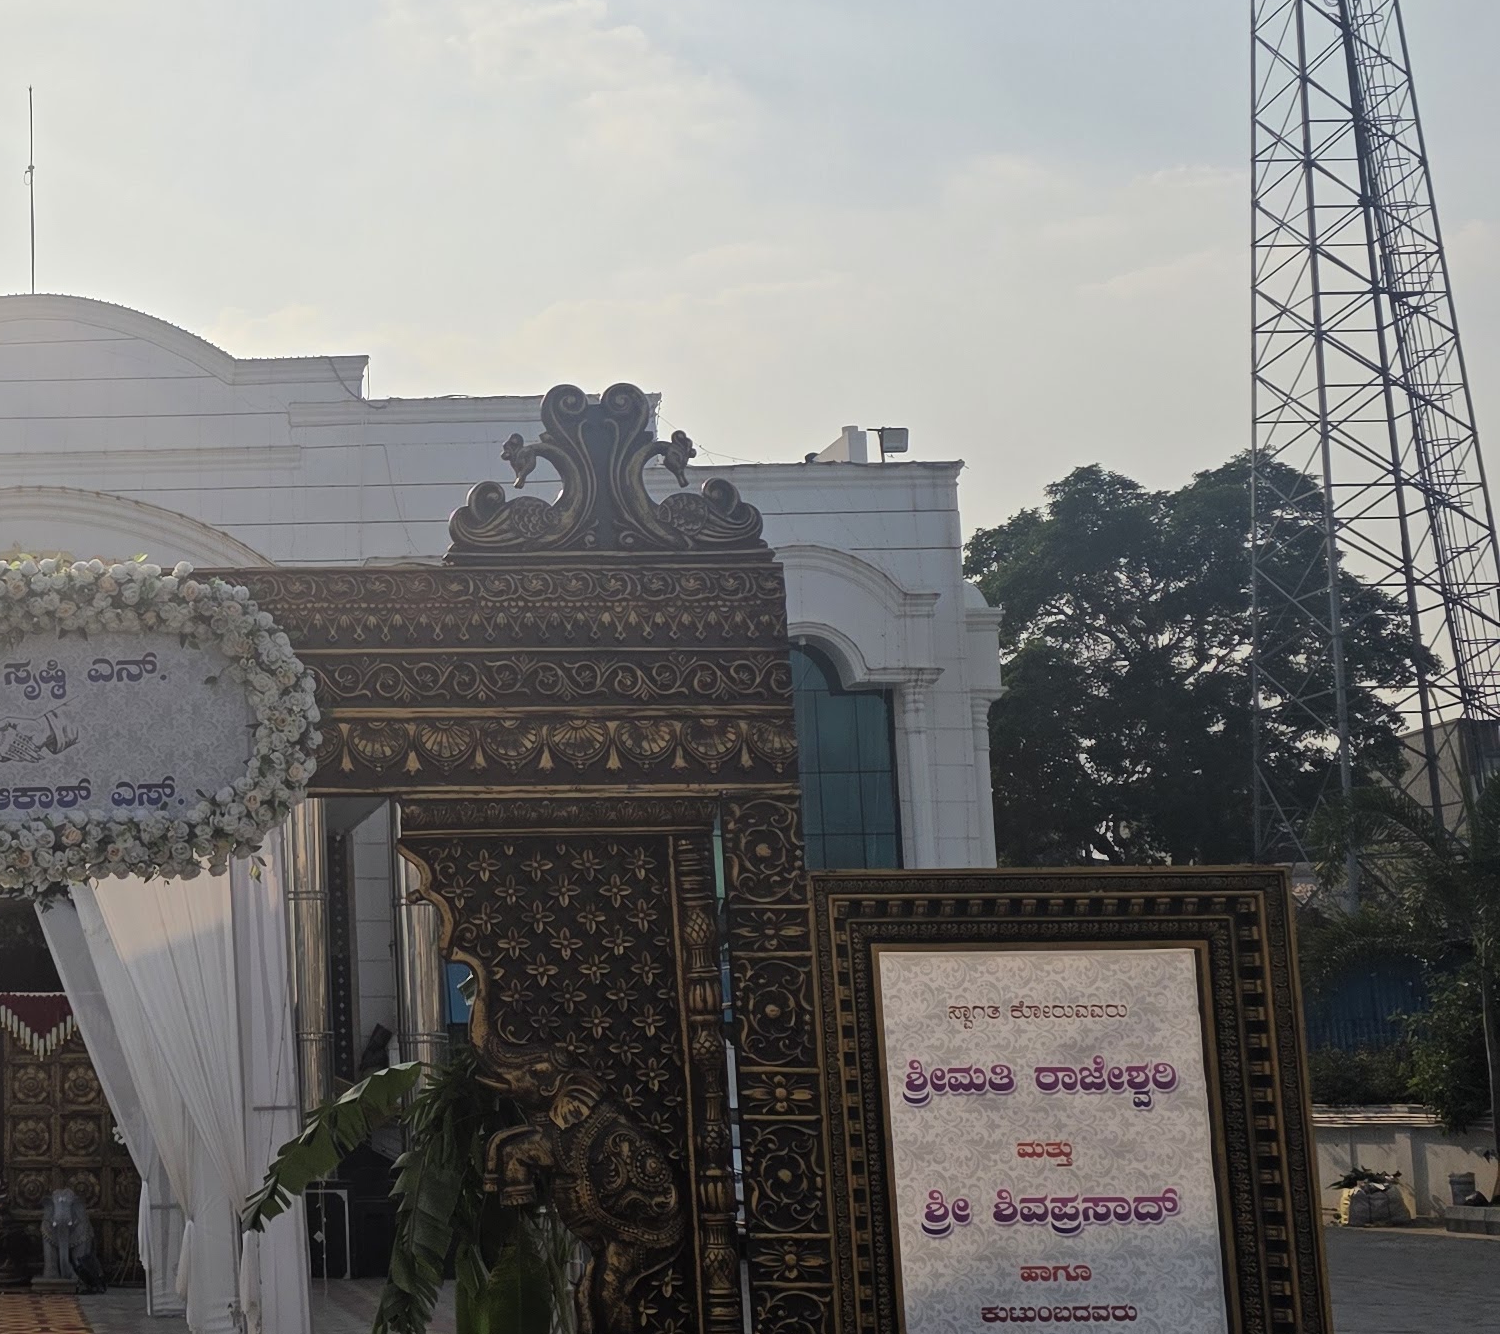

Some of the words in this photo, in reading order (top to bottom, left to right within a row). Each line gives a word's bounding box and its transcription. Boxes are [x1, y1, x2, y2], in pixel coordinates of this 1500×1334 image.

[949, 1006, 1000, 1029] ಸ್ವಾಗತ
[1010, 1001, 1127, 1018] ಕೋರುವವರು
[903, 1060, 1015, 1105] ಶ್ರೀಮತಿ
[1034, 1056, 1178, 1109] ರಾಜೇಶ್ವರಿ
[1017, 1141, 1072, 1167] ಮತ್ತು
[921, 1190, 971, 1235] ಶ್ರೀ
[993, 1188, 1180, 1234] ಶಿವಪ್ರಸಾದ್
[1021, 1264, 1091, 1282] ಹಾಗೂ
[981, 1304, 1137, 1323] ಕುಟುಂಬದವರು
